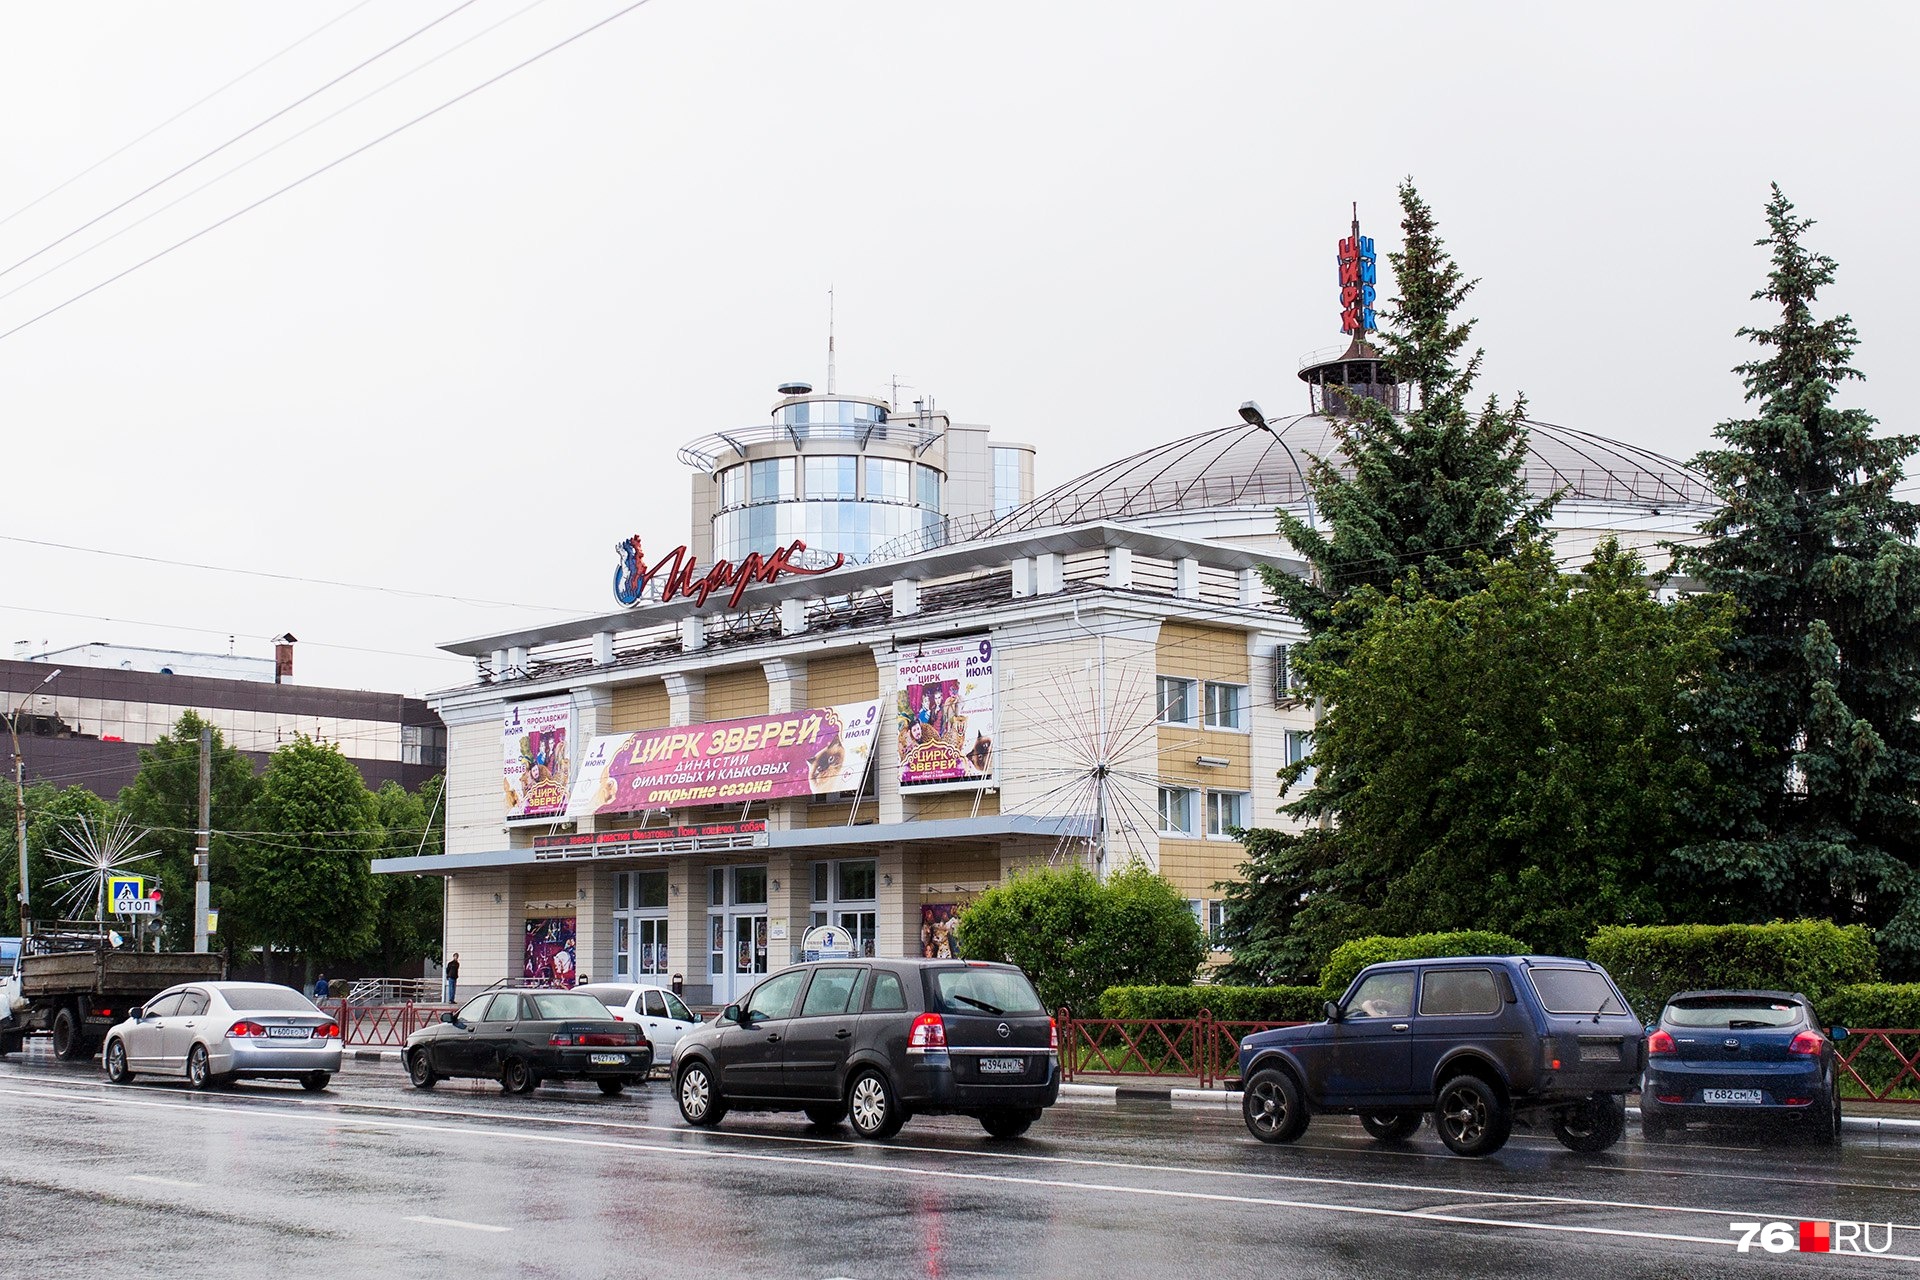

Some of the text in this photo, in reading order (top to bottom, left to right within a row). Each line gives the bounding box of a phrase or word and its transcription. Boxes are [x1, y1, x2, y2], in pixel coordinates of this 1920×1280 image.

[1339, 235, 1360, 332] ЦИРК
[1360, 235, 1378, 331] ЦИРК
[979, 639, 992, 664] 9
[899, 658, 960, 675] ЯРОСЛАВСКИЙ
[965, 665, 992, 678] ИЮЛЯ
[918, 673, 941, 684] ЦИРК
[512, 706, 521, 726] 1
[526, 711, 568, 725] ЯРОСЛАВСКИЙ
[865, 705, 877, 725] 9
[504, 726, 523, 736] ИЮНЯ
[845, 728, 870, 739] ИЮЛЯ
[629, 714, 823, 765] ЦИРК ЗВЕРЕЙ
[596, 742, 606, 758] 1
[917, 749, 949, 763] ЦИРК
[584, 759, 606, 767] ИЮНЯ
[674, 754, 750, 772] ДИНАСТИИ
[909, 758, 957, 773] ЗВЕРЕЙ
[631, 761, 791, 789] ФИЛАТОВЫХ И КЛЫКОВЫХ
[535, 787, 558, 798] ЦИРК
[648, 779, 773, 804] открытие сезона
[119, 901, 151, 911] СТОП
